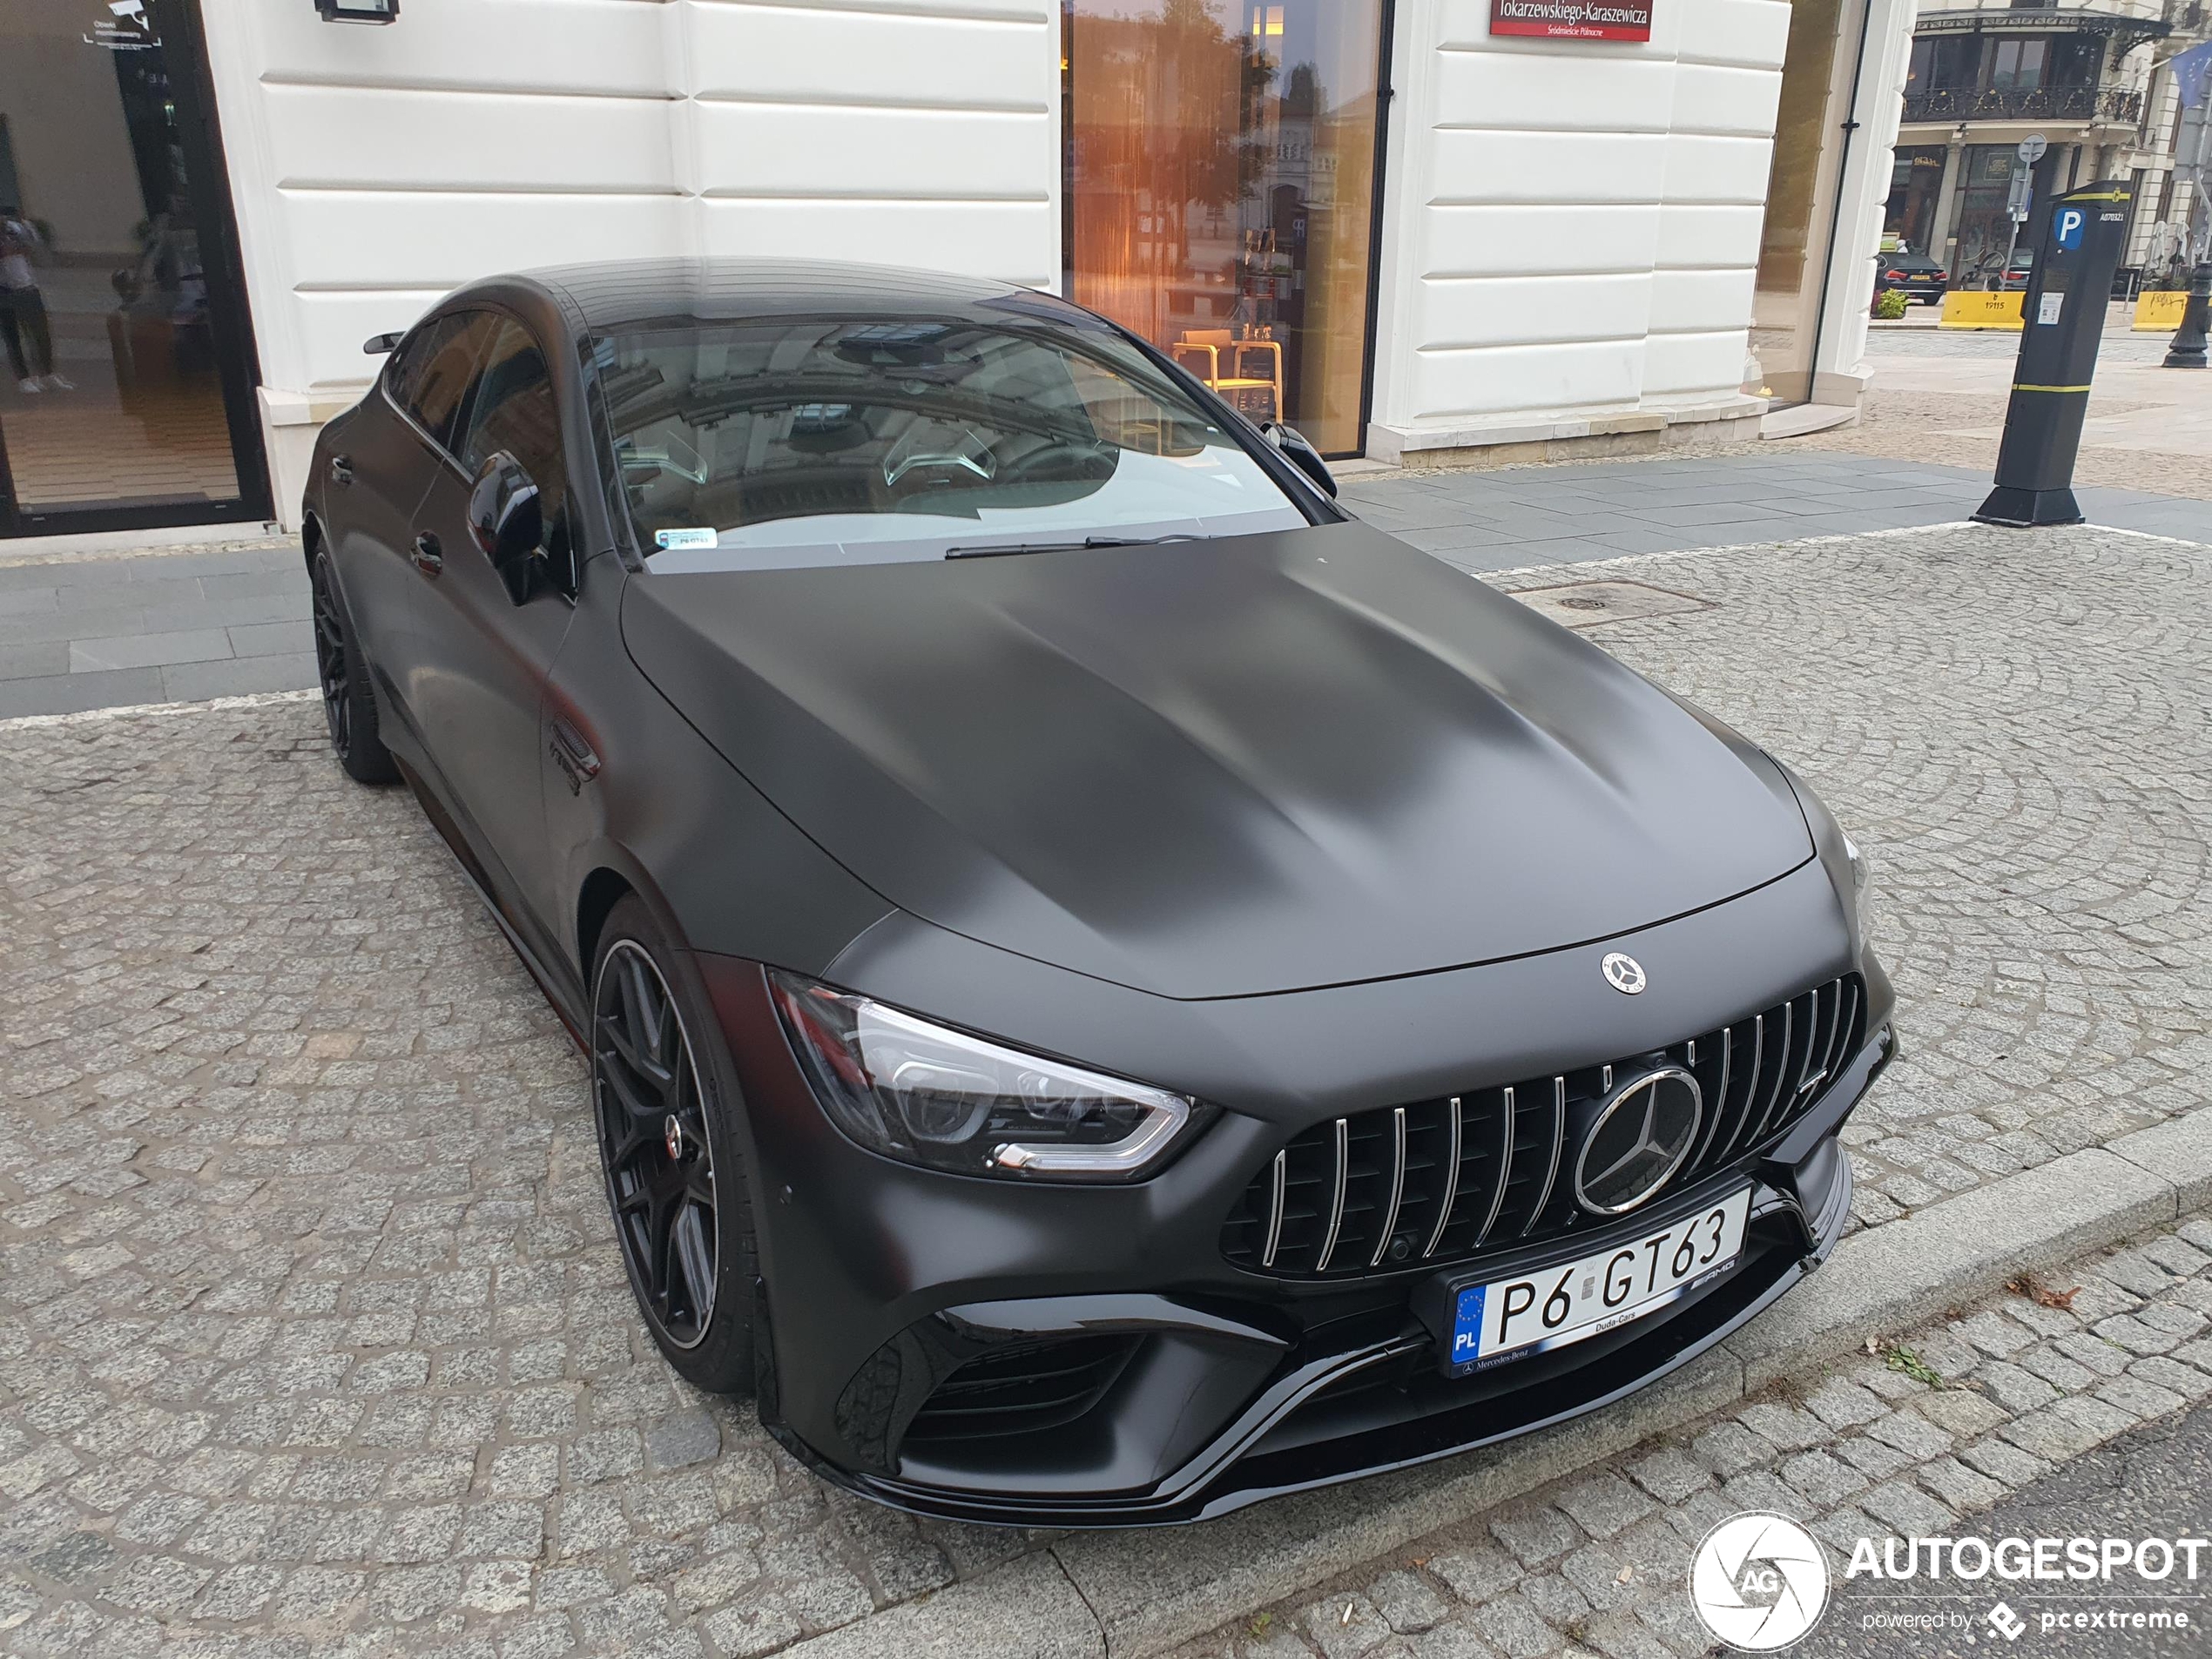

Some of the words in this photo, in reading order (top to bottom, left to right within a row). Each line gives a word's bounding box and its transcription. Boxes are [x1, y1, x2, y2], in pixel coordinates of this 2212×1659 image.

[2060, 211, 2081, 241] P
[1498, 1268, 1575, 1345] P6
[1602, 1208, 1725, 1307] GT63
[1595, 1312, 1635, 1332] Duda-Cars
[1455, 1332, 1476, 1351] PL
[1476, 1349, 1529, 1371] Mercedes-Benz
